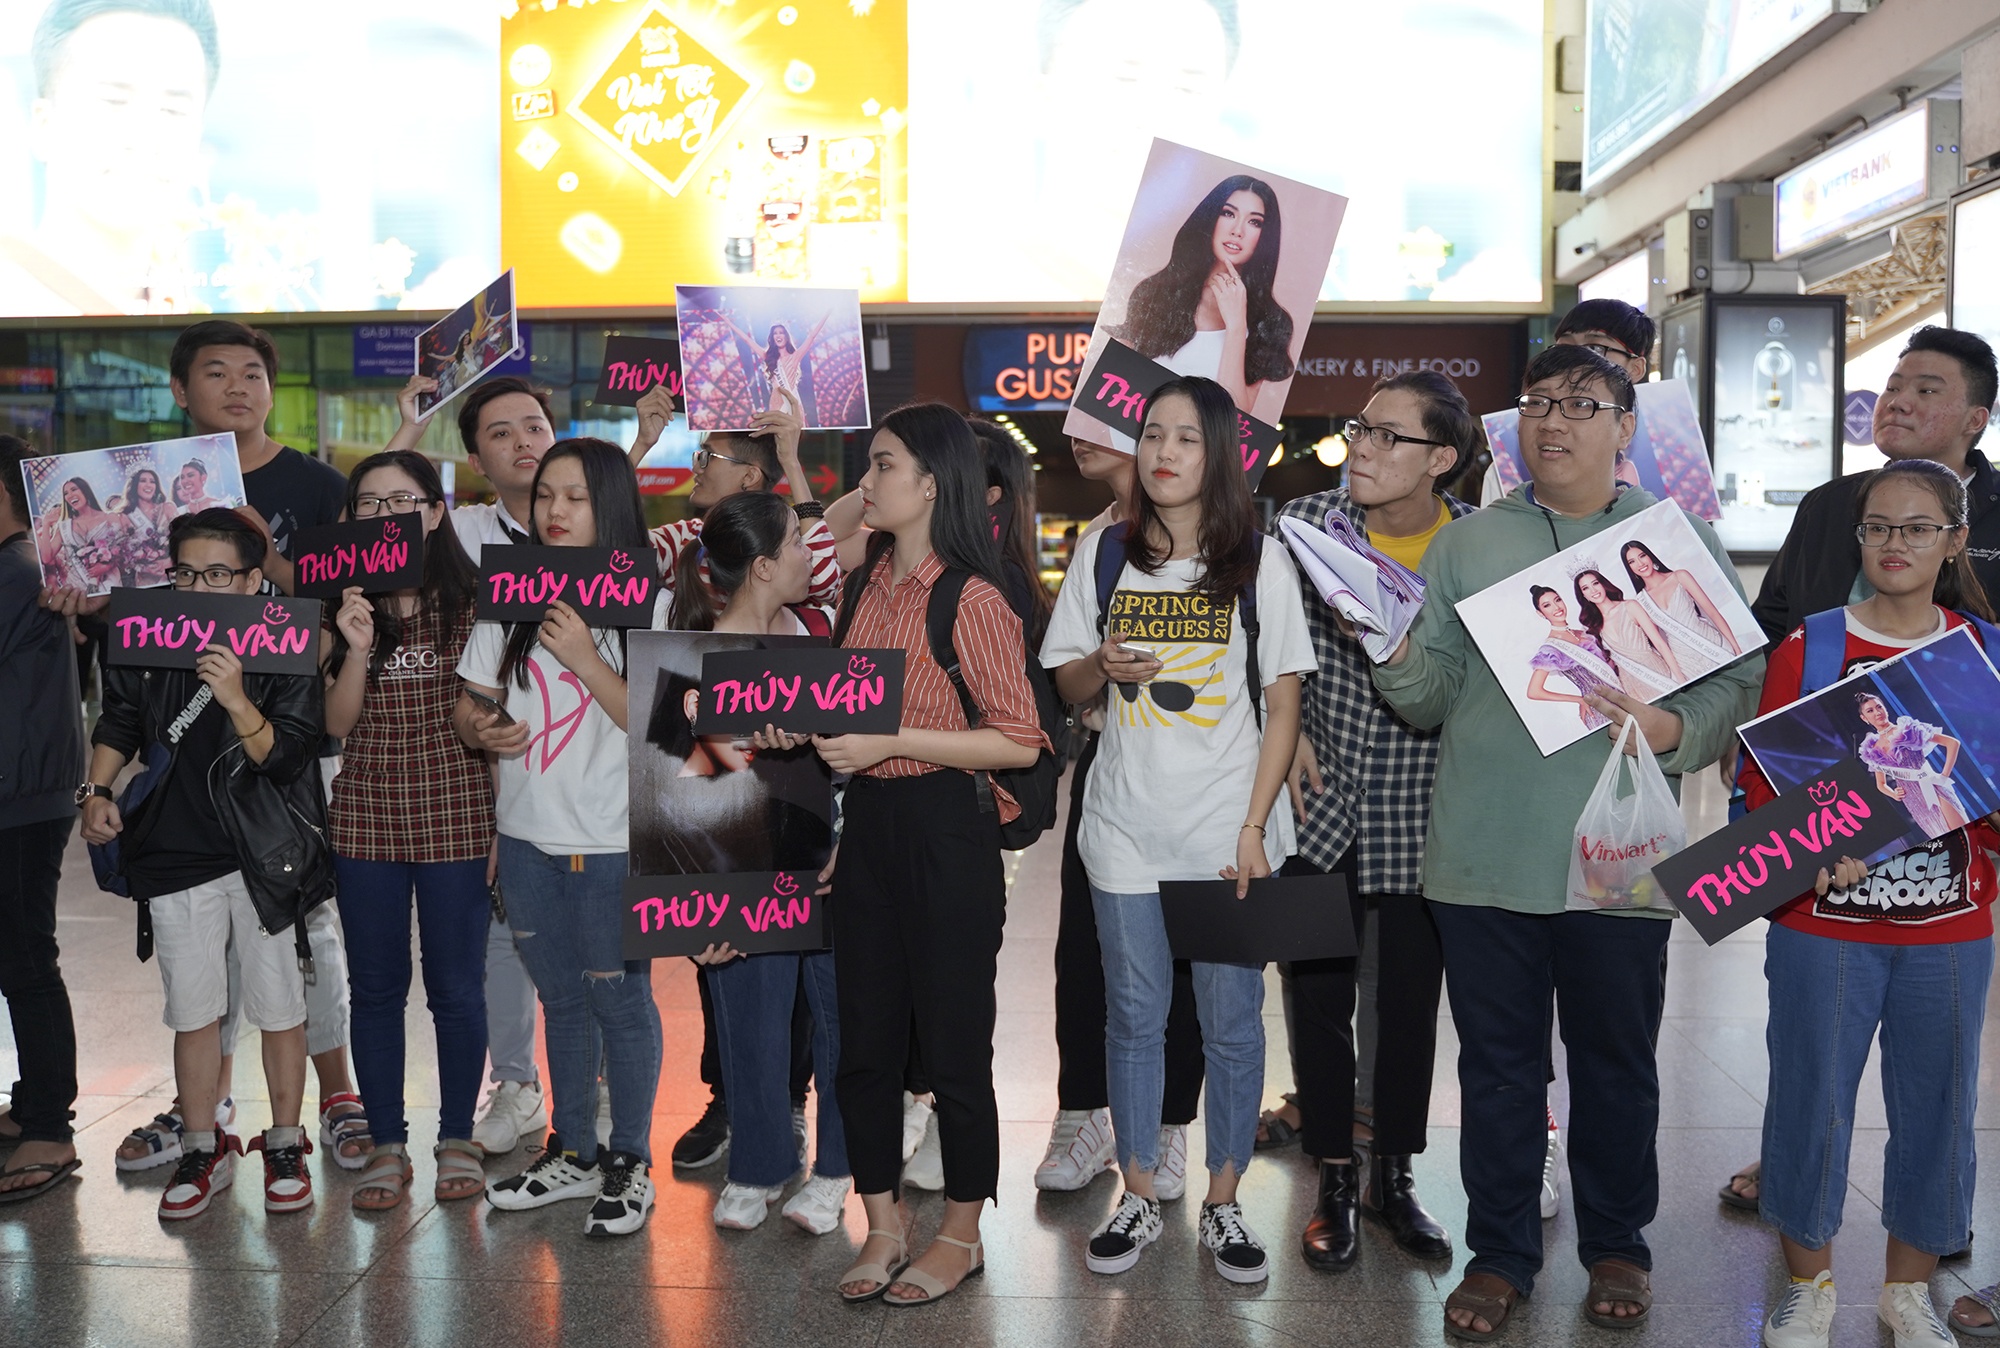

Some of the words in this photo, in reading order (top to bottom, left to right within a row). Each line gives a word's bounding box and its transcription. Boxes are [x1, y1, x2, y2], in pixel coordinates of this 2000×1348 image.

[608, 358, 669, 392] THÚY
[1352, 358, 1367, 377] &
[299, 543, 356, 584] THÚY
[489, 566, 568, 604] THÚY
[1111, 594, 1212, 617] SPRING
[1213, 603, 1230, 640] 201
[116, 614, 216, 652] THÚY
[1704, 644, 1720, 659] 2019
[712, 670, 802, 715] THÚY
[1686, 830, 1793, 915] THÚY
[1867, 850, 1951, 881] NCLE
[632, 890, 730, 934] THÚY
